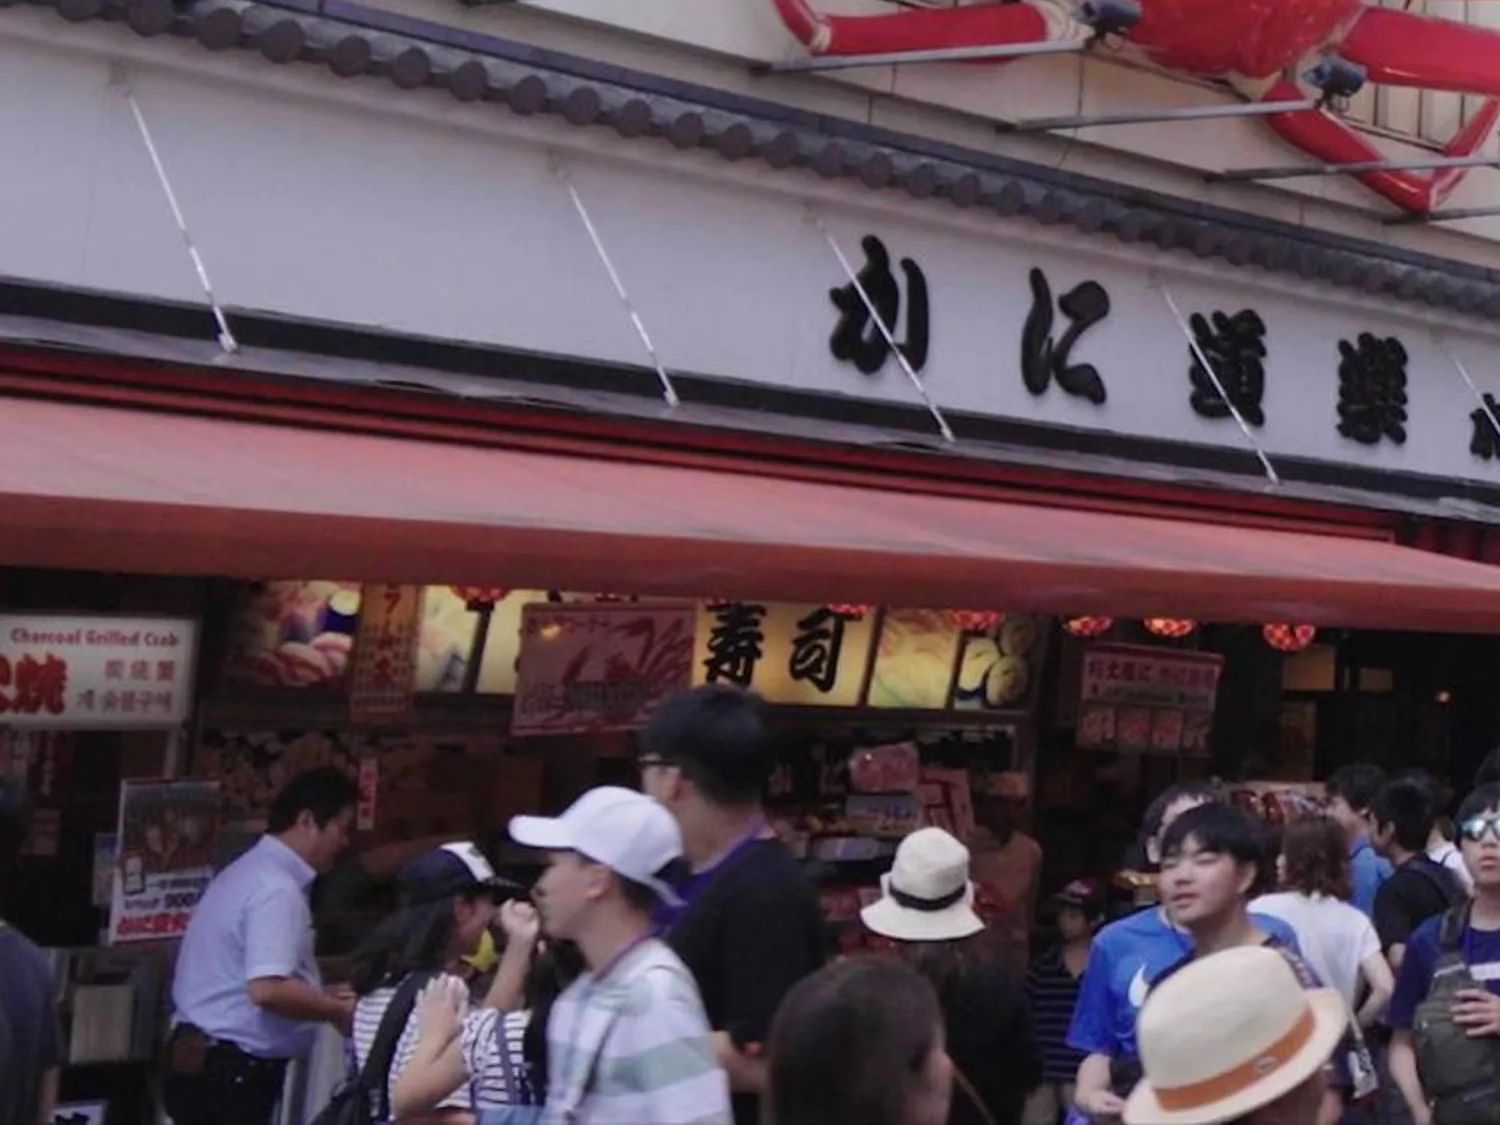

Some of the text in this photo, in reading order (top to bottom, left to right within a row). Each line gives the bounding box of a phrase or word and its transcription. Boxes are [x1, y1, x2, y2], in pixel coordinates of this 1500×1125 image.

[11, 627, 179, 647] Charcoal Grilled Crab
[703, 602, 849, 692] 寿司
